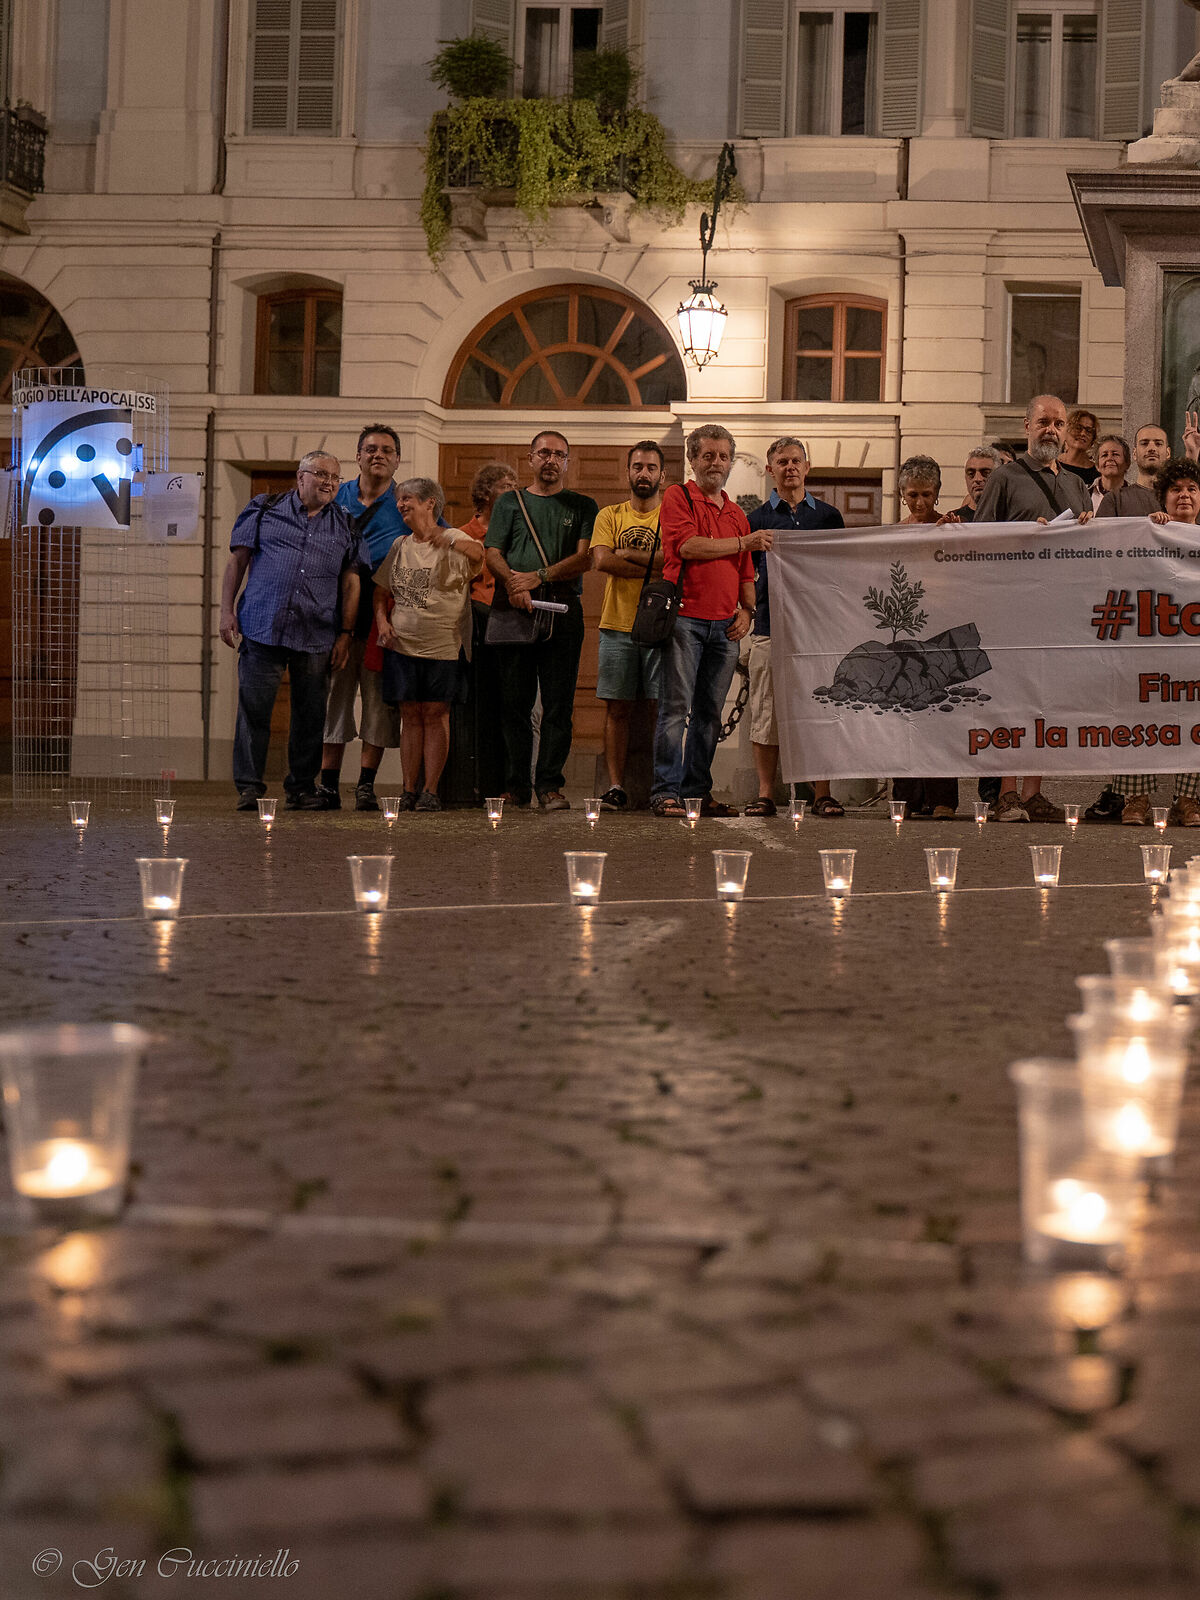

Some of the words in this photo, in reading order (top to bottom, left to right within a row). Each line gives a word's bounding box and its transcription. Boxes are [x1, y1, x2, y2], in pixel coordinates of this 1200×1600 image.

[47, 388, 155, 411] DELL'APOCALISSE
[933, 549, 1036, 563] Coordinamento
[1038, 548, 1052, 560] di
[1054, 547, 1113, 560] cittadine
[1115, 549, 1124, 558] e
[1126, 546, 1184, 560] cittadini,
[968, 725, 1026, 755] per
[1035, 718, 1068, 748] la
[1078, 722, 1182, 748] messa
